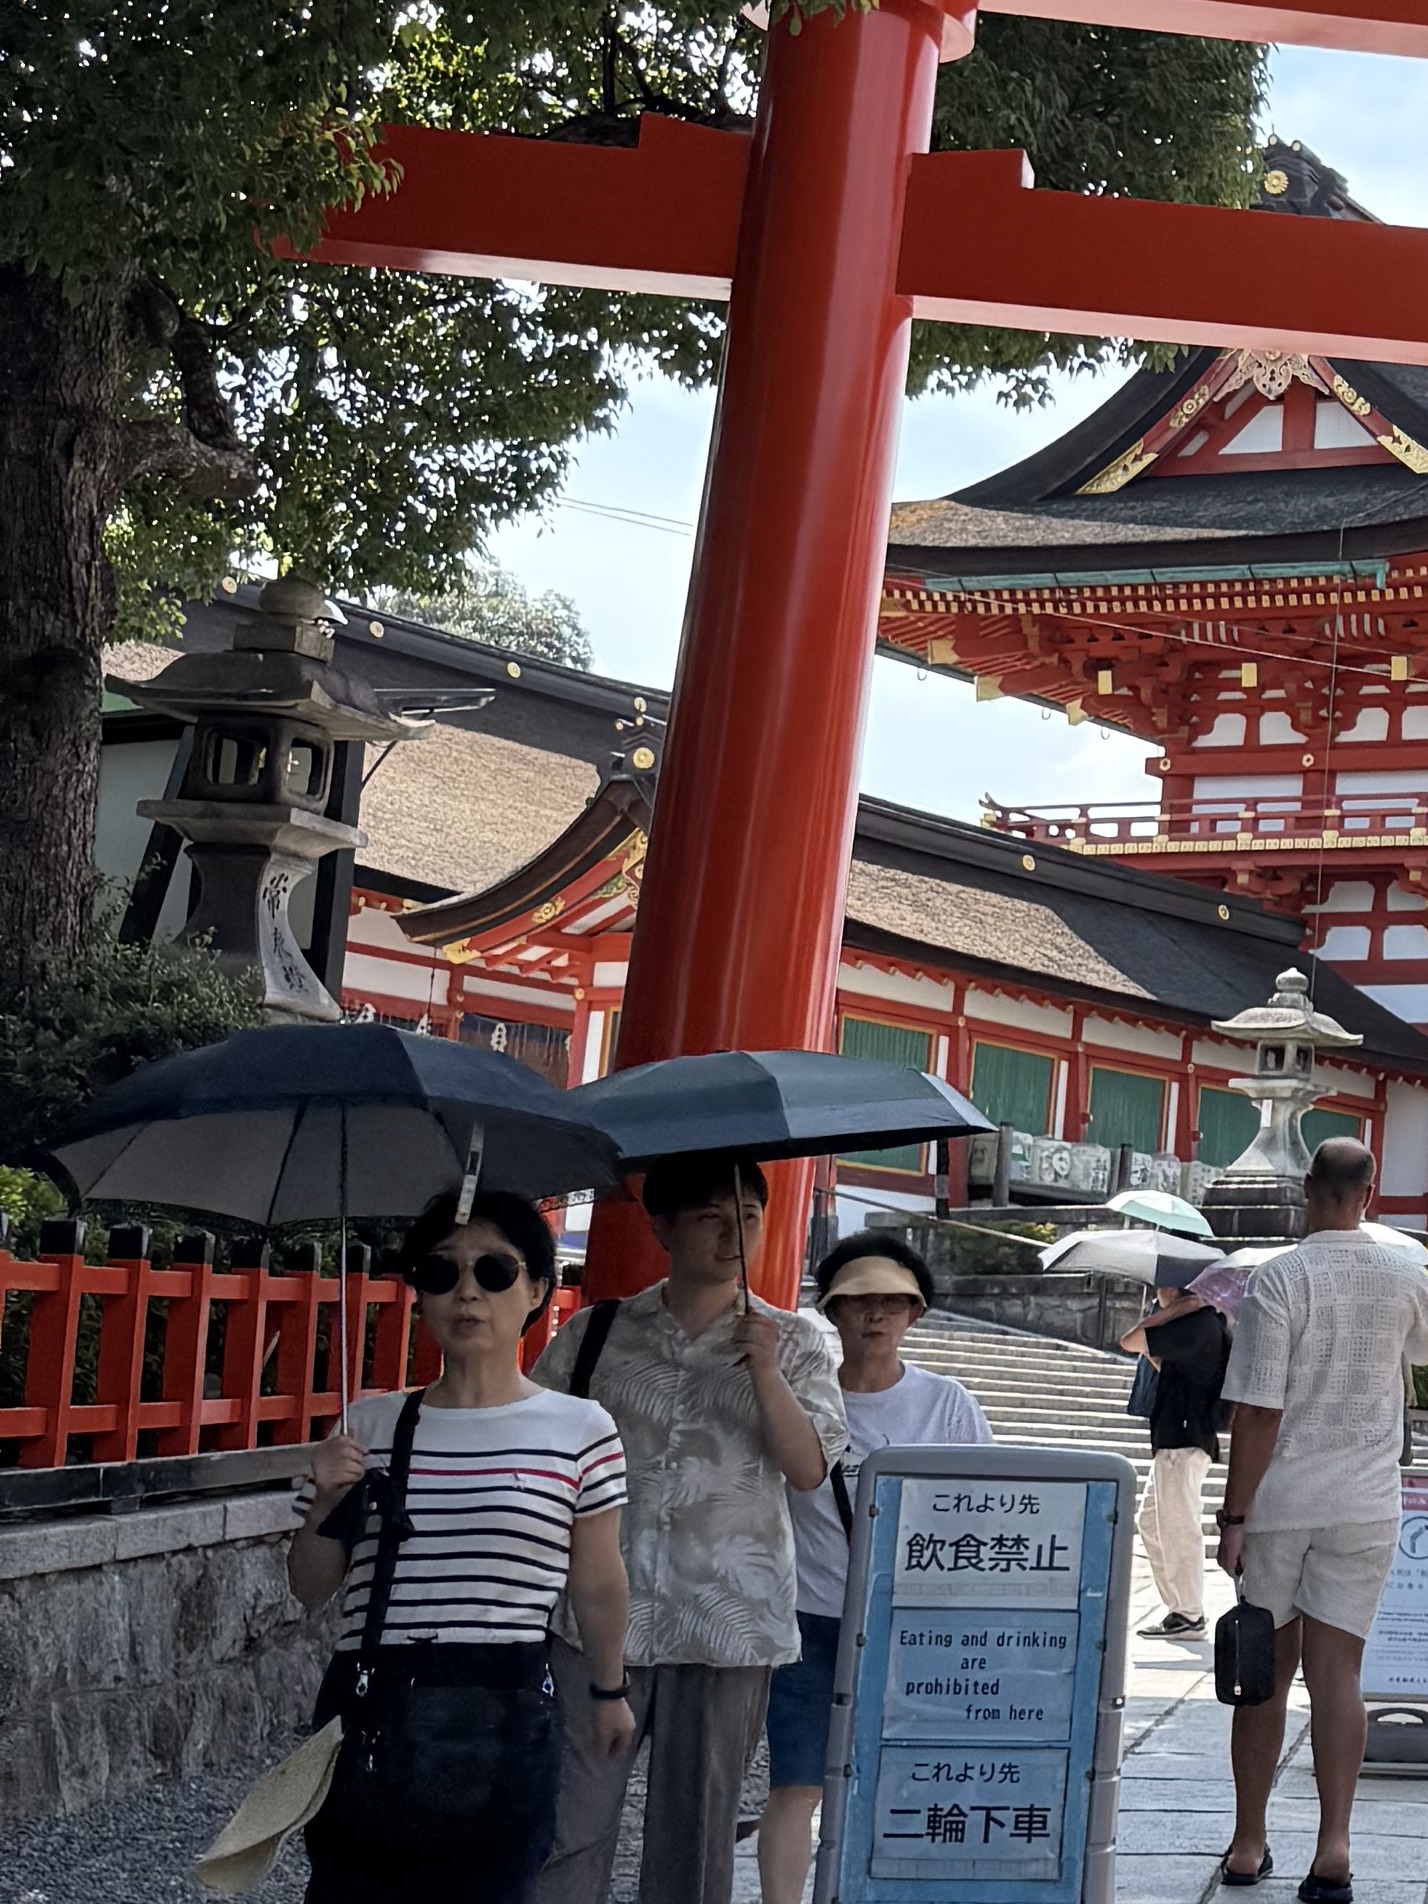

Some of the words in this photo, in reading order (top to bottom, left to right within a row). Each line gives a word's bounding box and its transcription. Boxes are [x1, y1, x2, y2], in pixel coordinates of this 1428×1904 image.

[932, 1492, 1041, 1515] これより先
[904, 1532, 1071, 1573] 飲食禁止
[899, 1630, 953, 1648] Eating
[960, 1631, 988, 1647] and
[996, 1631, 1067, 1649] drinking
[960, 1657, 987, 1670] are
[905, 1678, 1000, 1696] prohibited
[965, 1704, 1000, 1720] from
[1009, 1704, 1044, 1721] here
[911, 1762, 1021, 1784] これより先
[883, 1802, 1052, 1844] 二輪下車
